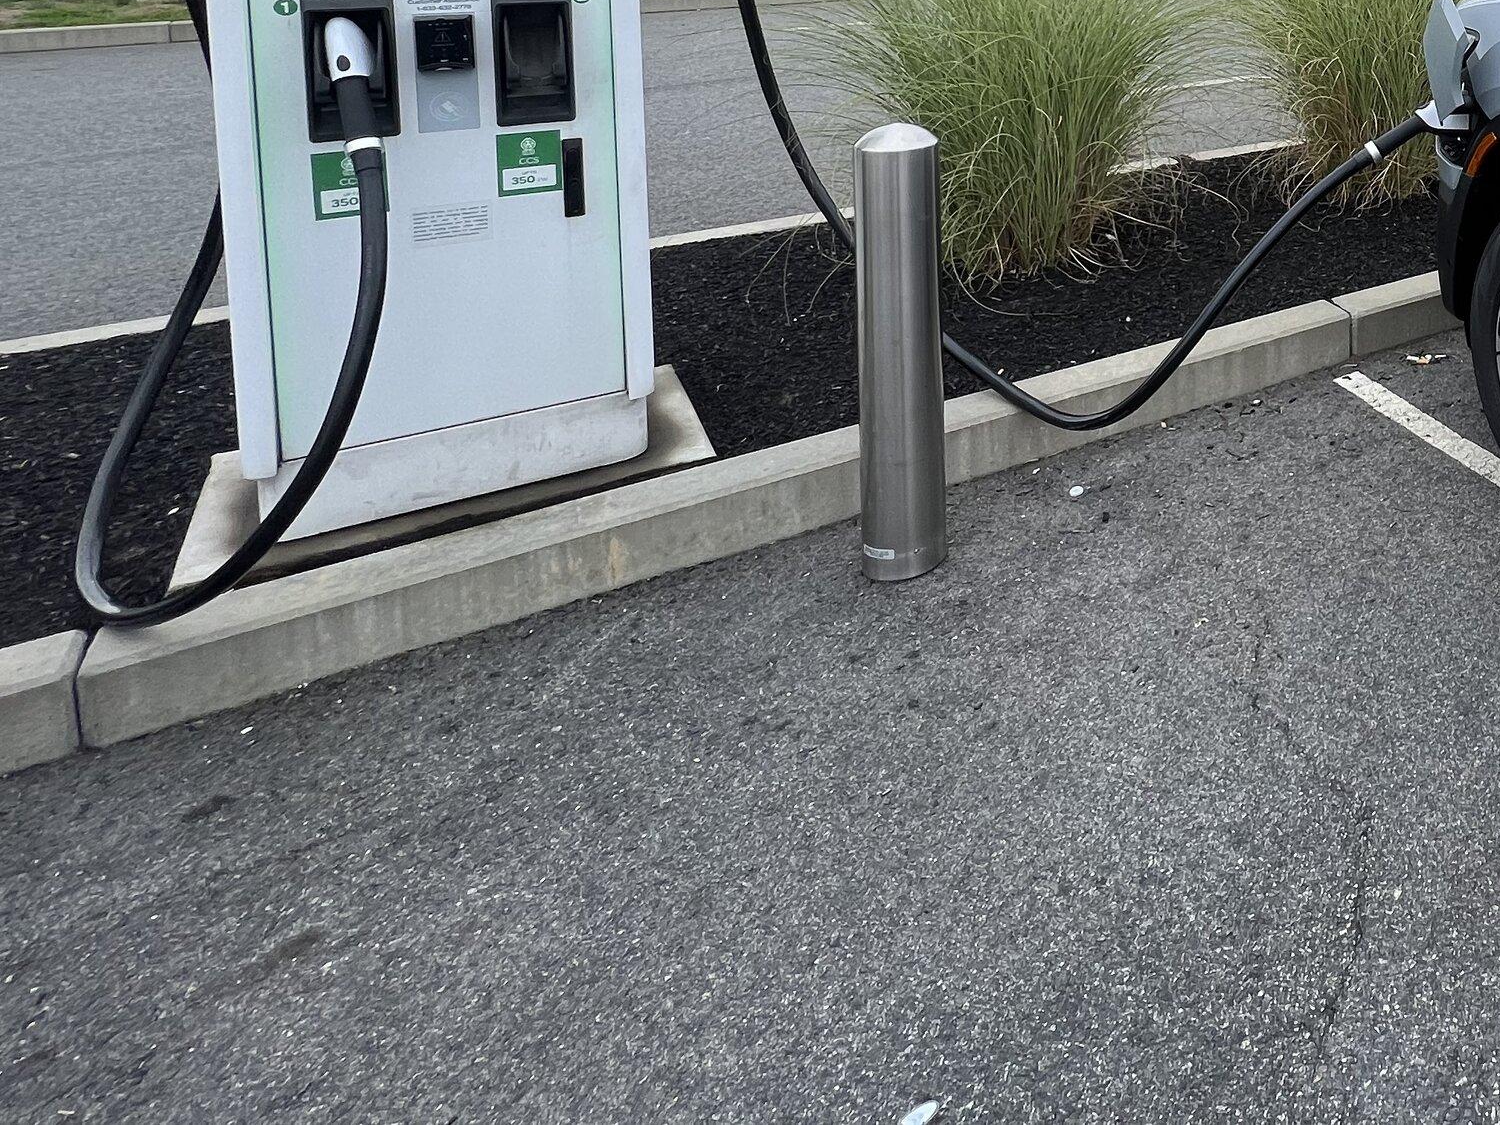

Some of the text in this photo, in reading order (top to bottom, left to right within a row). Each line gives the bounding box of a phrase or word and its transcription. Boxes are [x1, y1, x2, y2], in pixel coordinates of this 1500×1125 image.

[280, 1, 289, 13] 1
[518, 156, 540, 165] CCS
[339, 177, 359, 186] CC
[511, 175, 536, 185] 350
[331, 197, 359, 208] 350
